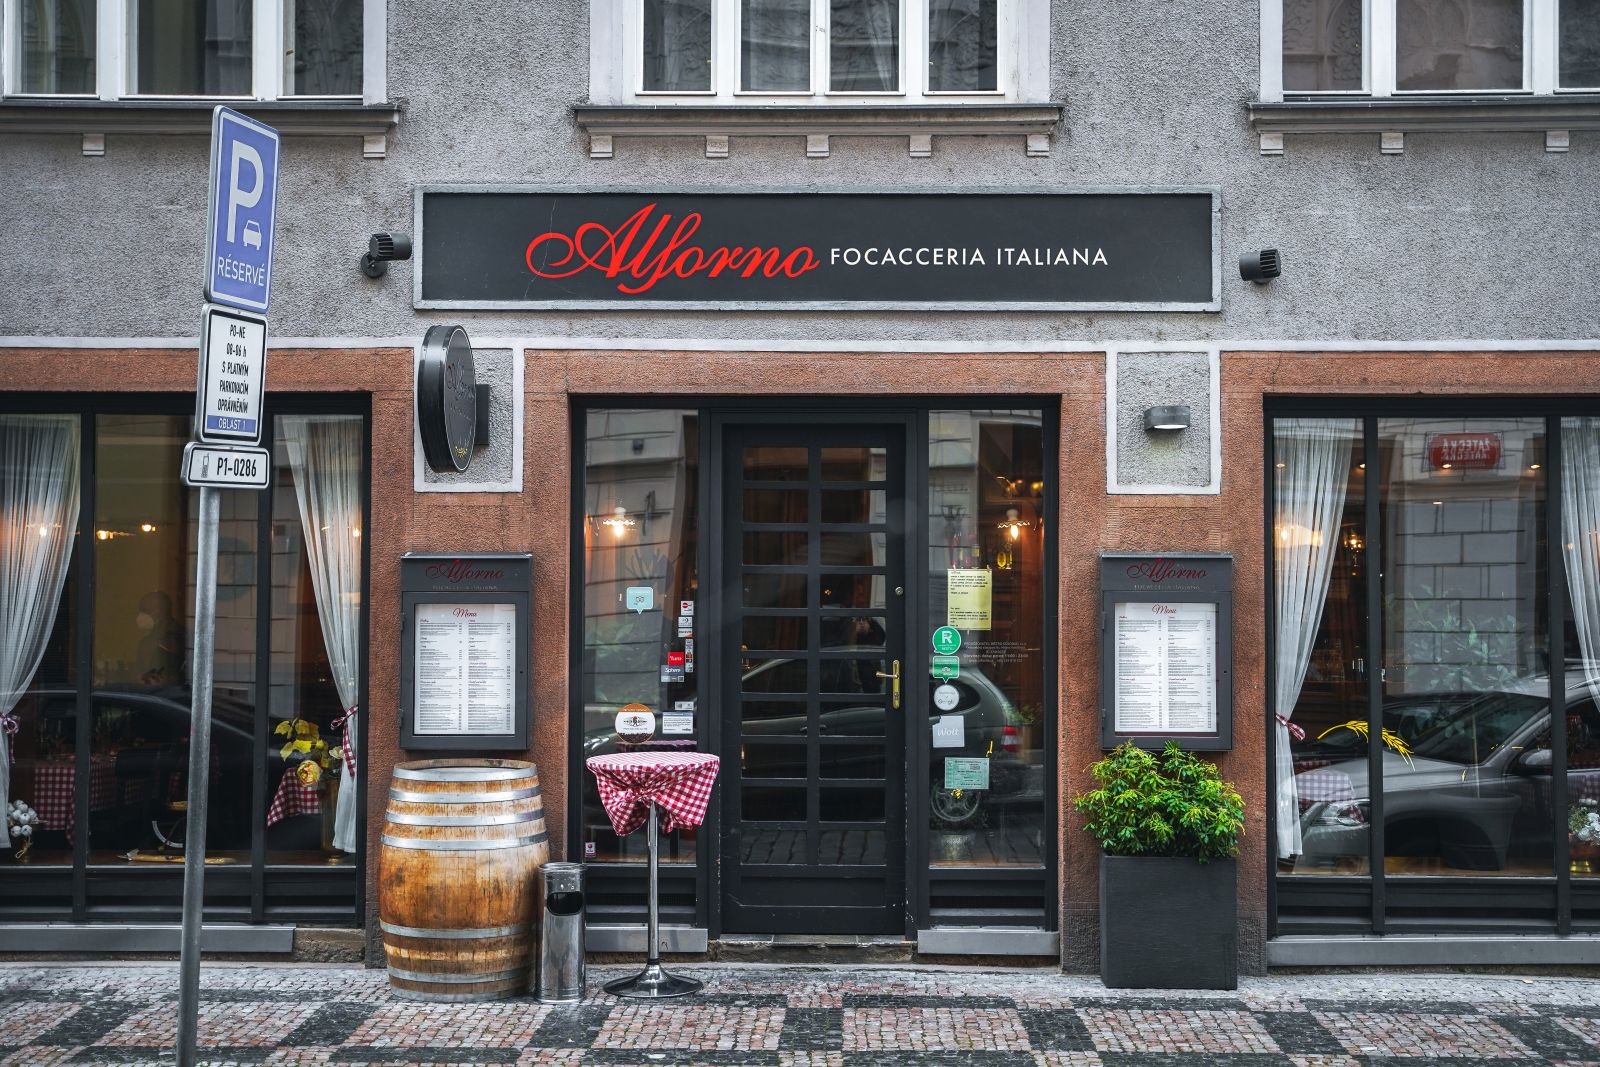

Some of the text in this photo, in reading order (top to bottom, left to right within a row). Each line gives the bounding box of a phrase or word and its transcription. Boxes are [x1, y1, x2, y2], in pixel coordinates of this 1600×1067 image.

[227, 139, 264, 244] P
[525, 203, 1109, 294] Alforno FOCACCERIA ITALIANA
[217, 253, 266, 287] RÉSERVÉ
[229, 324, 246, 339] PO-NE
[226, 342, 247, 357] 08-06 h
[222, 361, 249, 376] S PLATNÝM
[219, 379, 249, 395] PARKOVACÍM
[218, 397, 249, 414] OPRÁVNĚNÍM
[218, 417, 242, 430] OBLAST
[217, 457, 257, 477] P1-0286
[1127, 557, 1208, 583] Alforno
[452, 607, 478, 618] Menu
[1151, 604, 1177, 614] Menu
[937, 727, 960, 737] Wolt
